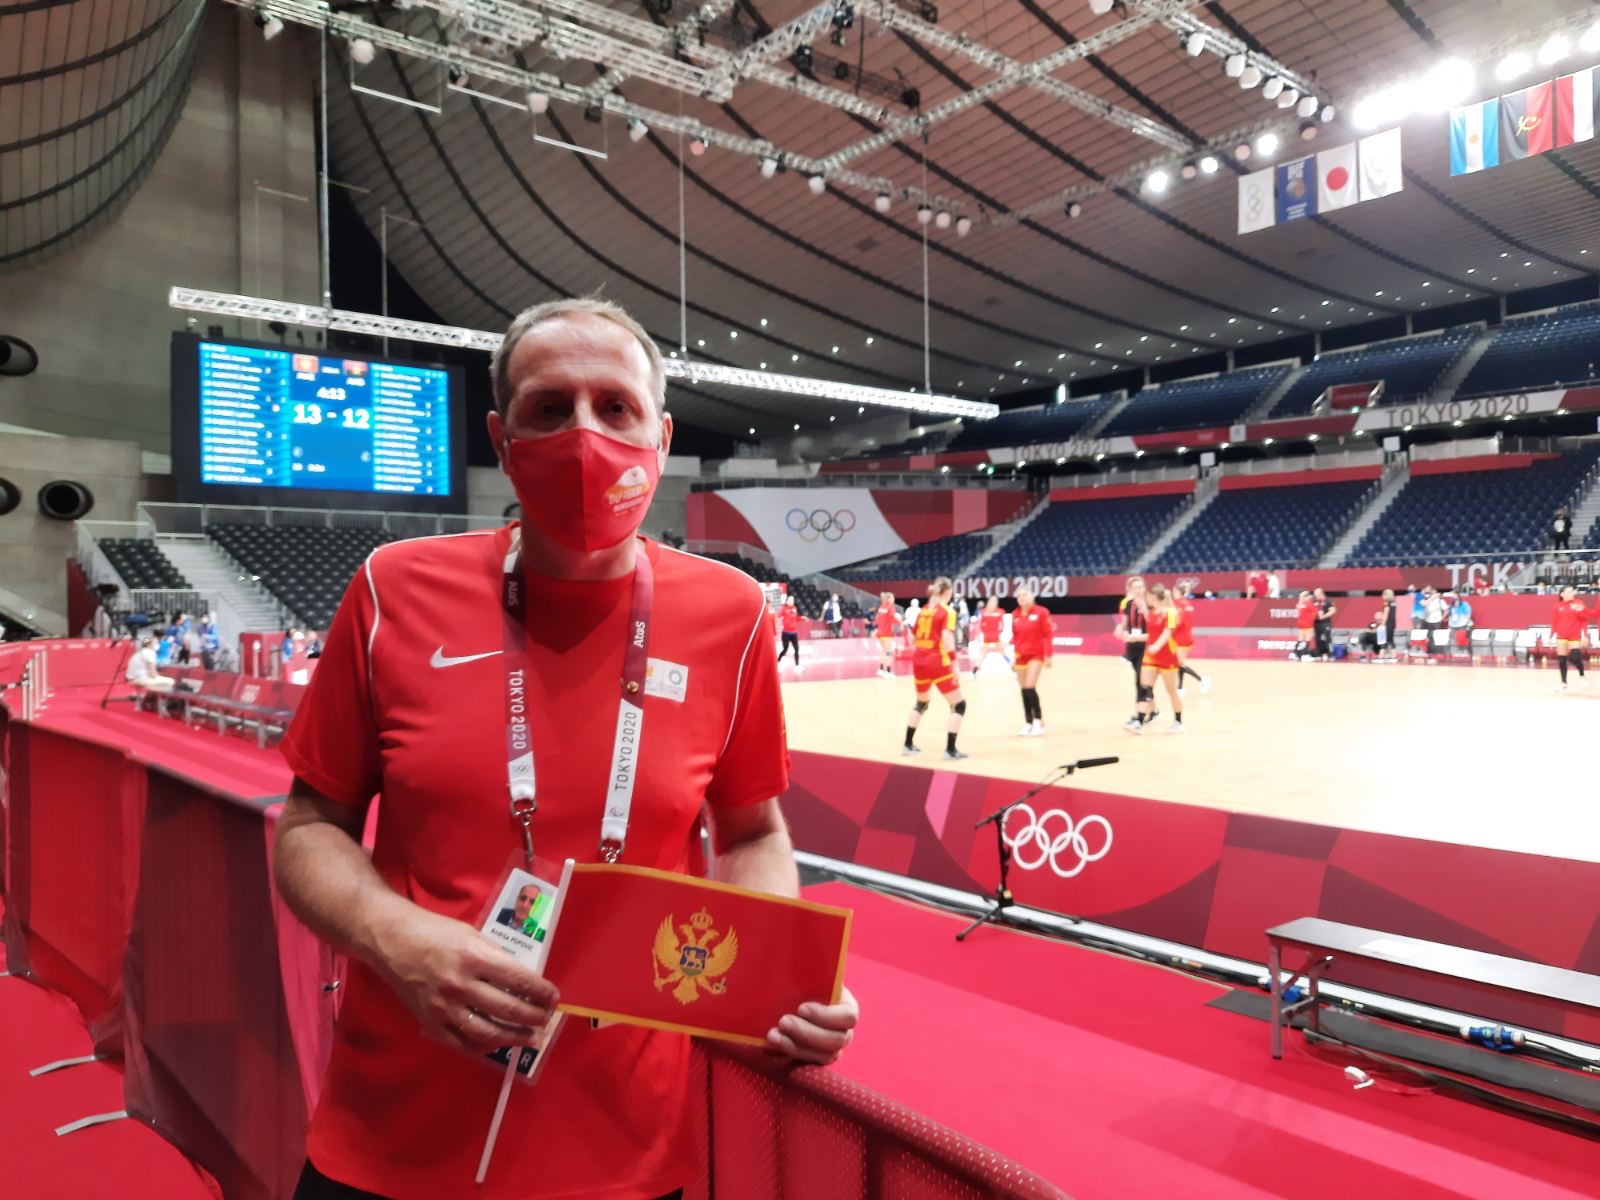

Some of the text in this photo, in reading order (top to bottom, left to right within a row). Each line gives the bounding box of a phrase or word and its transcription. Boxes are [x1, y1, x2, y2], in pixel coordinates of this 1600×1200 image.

[293, 403, 322, 425] 13
[342, 408, 370, 429] 12
[1385, 394, 1529, 428] TOKYO 2020
[948, 575, 1068, 599] OKYO 2020
[509, 669, 527, 750] TOKYO 2020
[614, 711, 637, 791] TOKYO 2020
